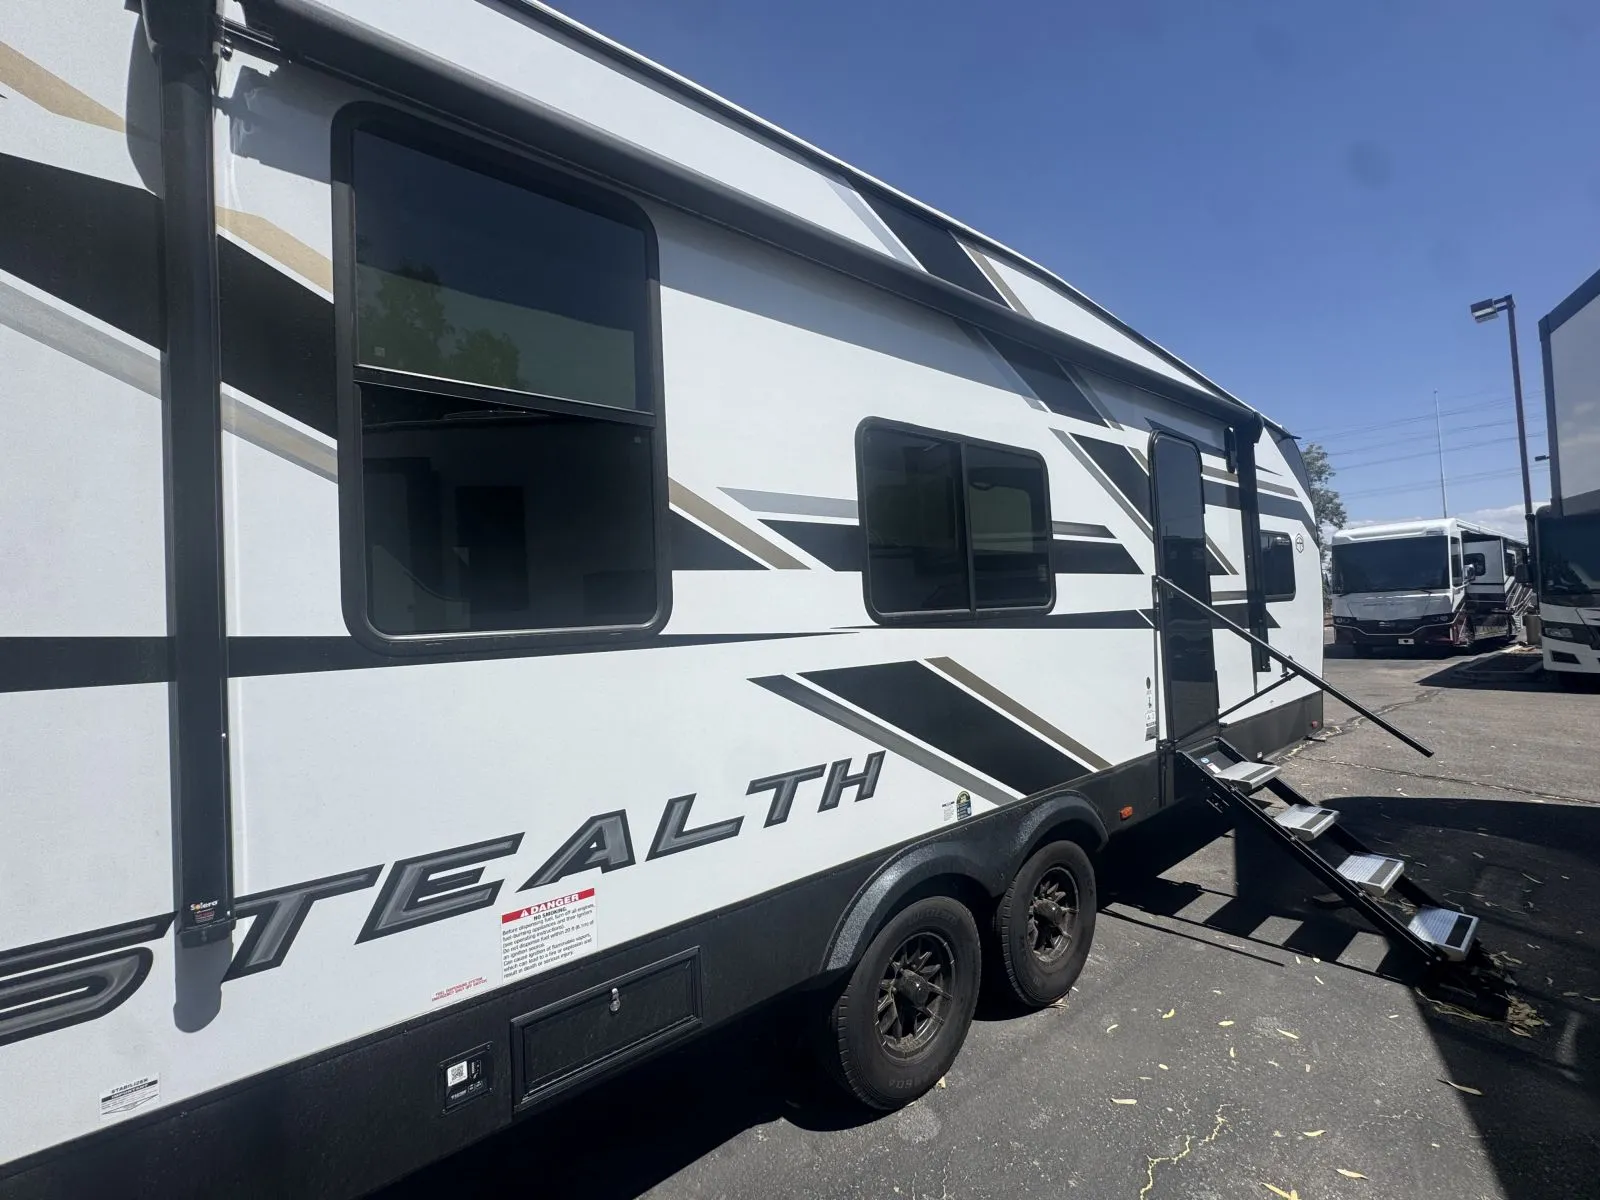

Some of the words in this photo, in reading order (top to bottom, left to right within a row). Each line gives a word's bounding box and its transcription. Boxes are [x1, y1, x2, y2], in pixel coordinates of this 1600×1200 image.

[190, 900, 218, 911] Solera
[531, 894, 579, 914] DANGER
[503, 927, 518, 935] Before
[519, 919, 543, 931] dispensing
[532, 921, 556, 933] appliances
[577, 910, 592, 918] igniters
[514, 935, 535, 945] operating
[519, 939, 540, 950] dispense
[504, 964, 518, 972] which
[563, 941, 583, 952] explosion
[510, 949, 527, 959] ignition
[514, 955, 527, 963] cause
[529, 948, 545, 958] ignition
[552, 938, 575, 950] flammable
[544, 956, 560, 964] serious
[112, 1078, 148, 1093] STABILIZER
